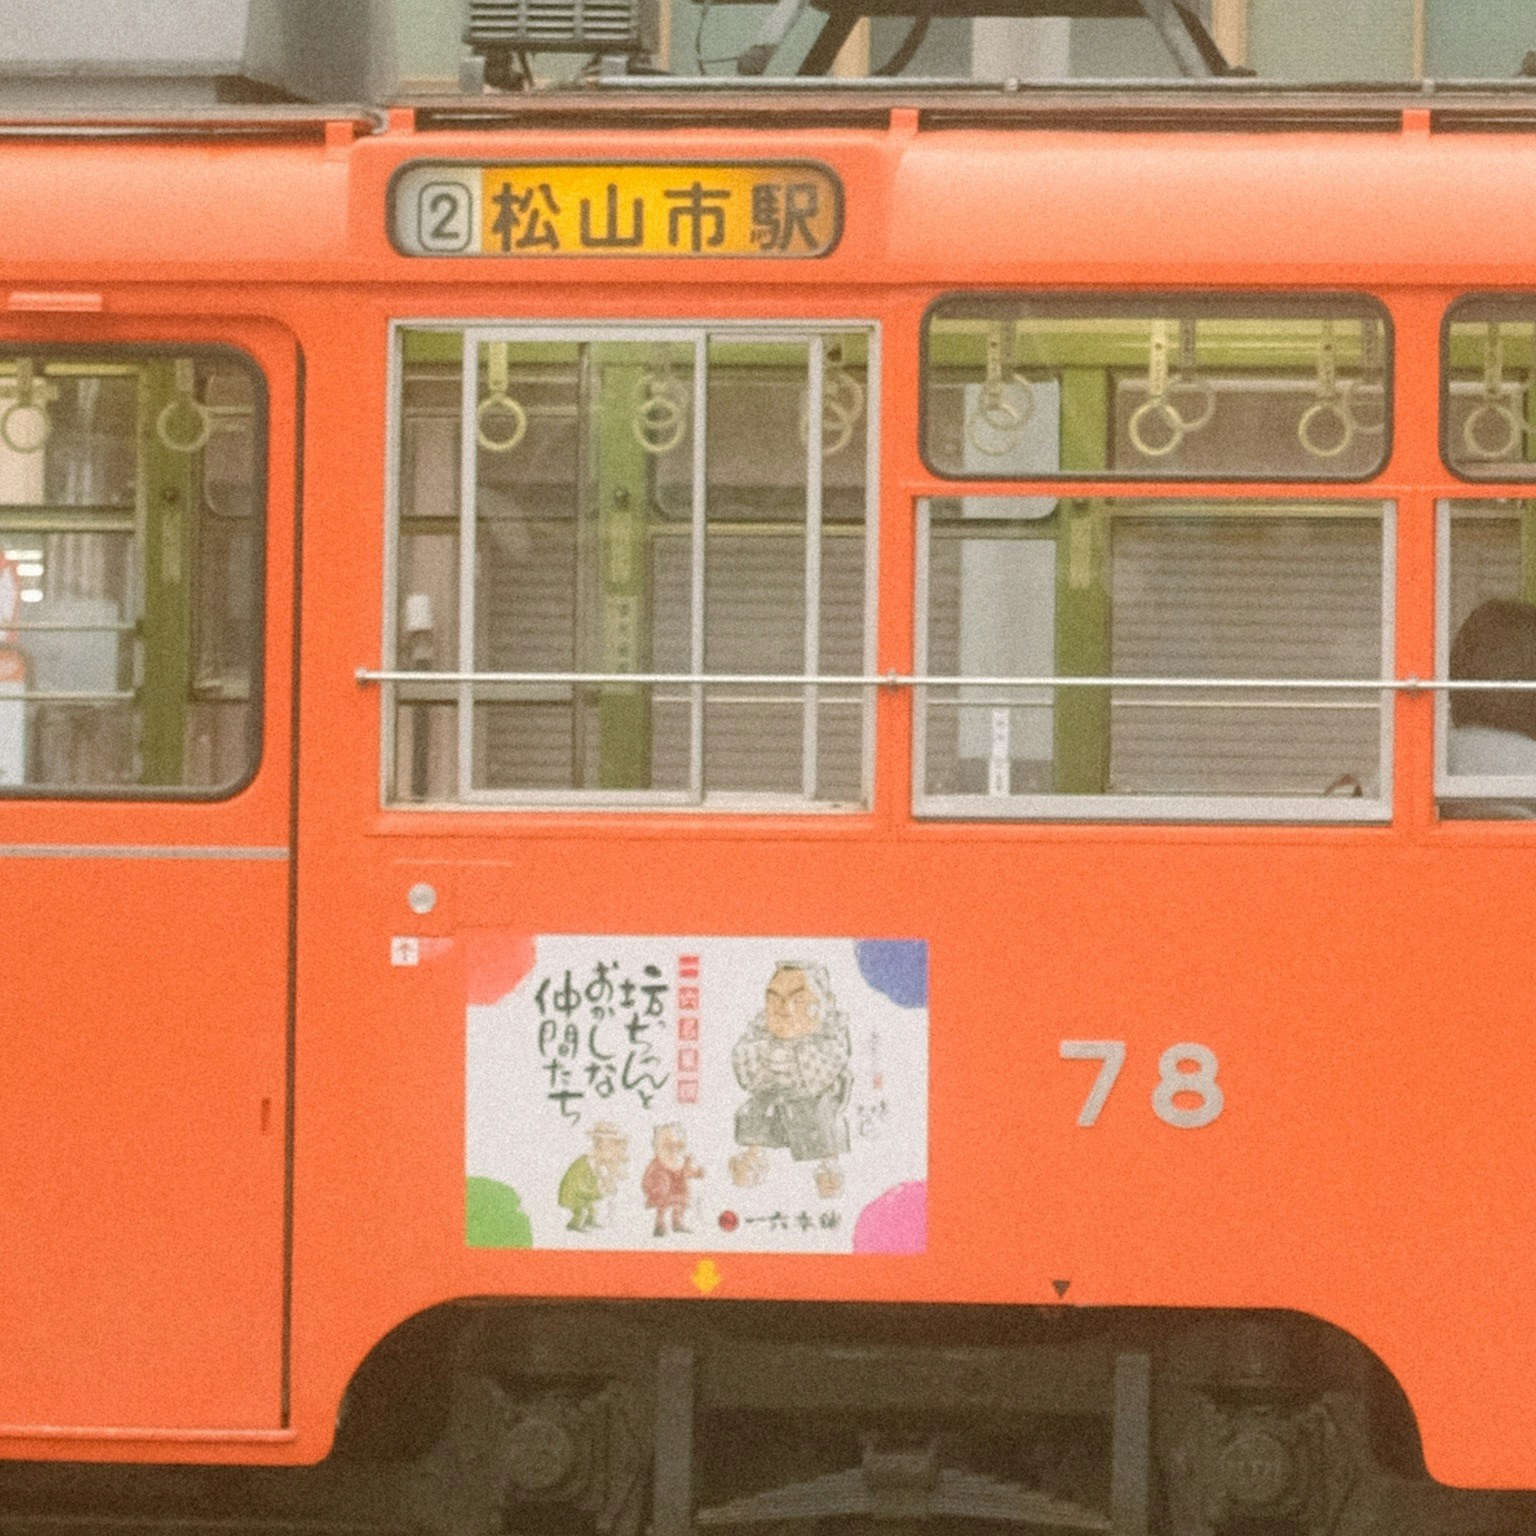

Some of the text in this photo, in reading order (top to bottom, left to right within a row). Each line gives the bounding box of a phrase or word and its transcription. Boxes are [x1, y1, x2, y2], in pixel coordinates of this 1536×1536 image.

[491, 180, 821, 253] 松山市駅
[534, 969, 584, 1127] 仲間たち
[1058, 1039, 1225, 1129] 78
